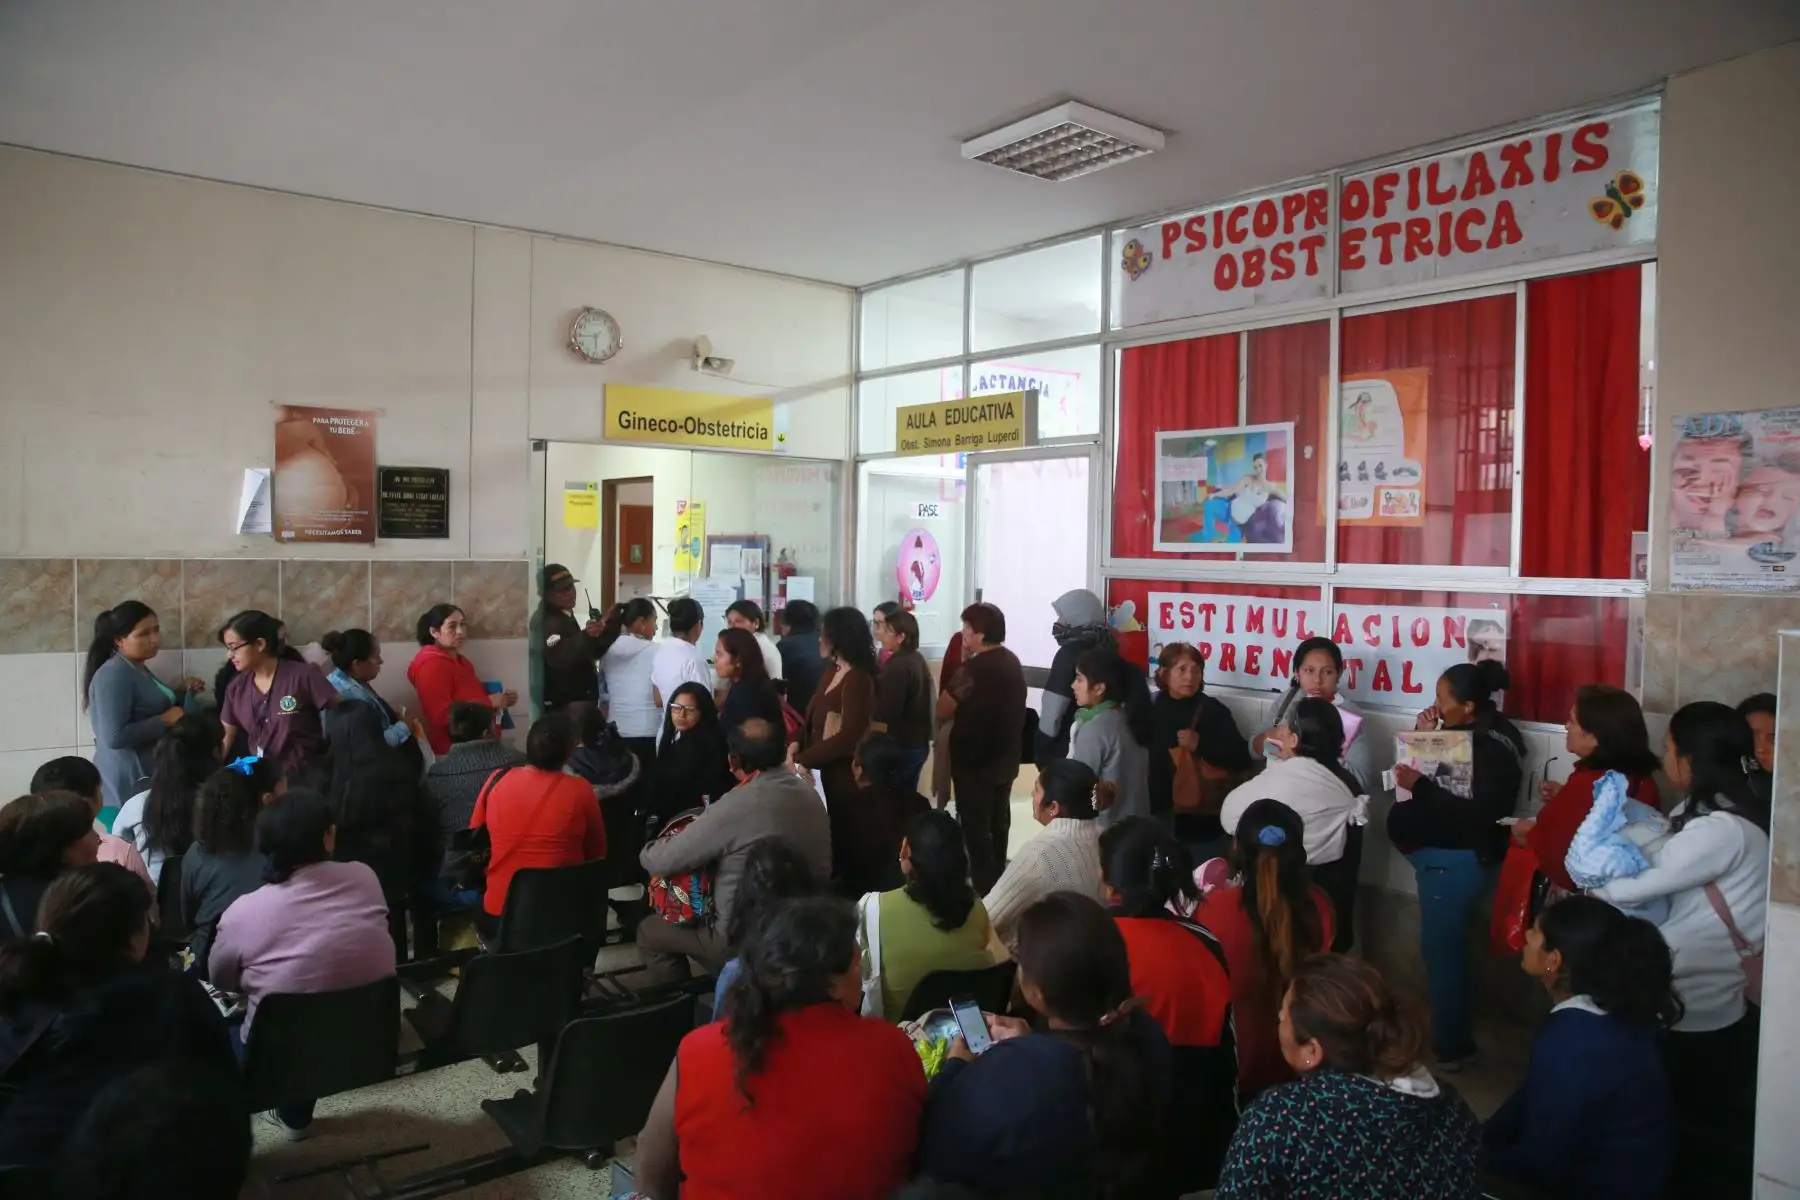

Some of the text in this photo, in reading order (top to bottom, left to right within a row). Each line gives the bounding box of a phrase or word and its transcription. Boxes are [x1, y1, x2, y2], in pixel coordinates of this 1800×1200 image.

[1161, 122, 1609, 260] PSICOPROFILAXIS
[1213, 200, 1522, 291] OBSTETRICA
[330, 417, 364, 427] PROTEGER
[618, 410, 768, 440] Gineco-Obstetricia
[906, 401, 1014, 430] AULA EDUCATIVA
[923, 436, 951, 449] Simona
[955, 432, 983, 447] Barriga
[918, 503, 939, 516] PASE
[1159, 601, 1466, 649] ESTIMULACION
[1197, 641, 1423, 694] PRENTAL
